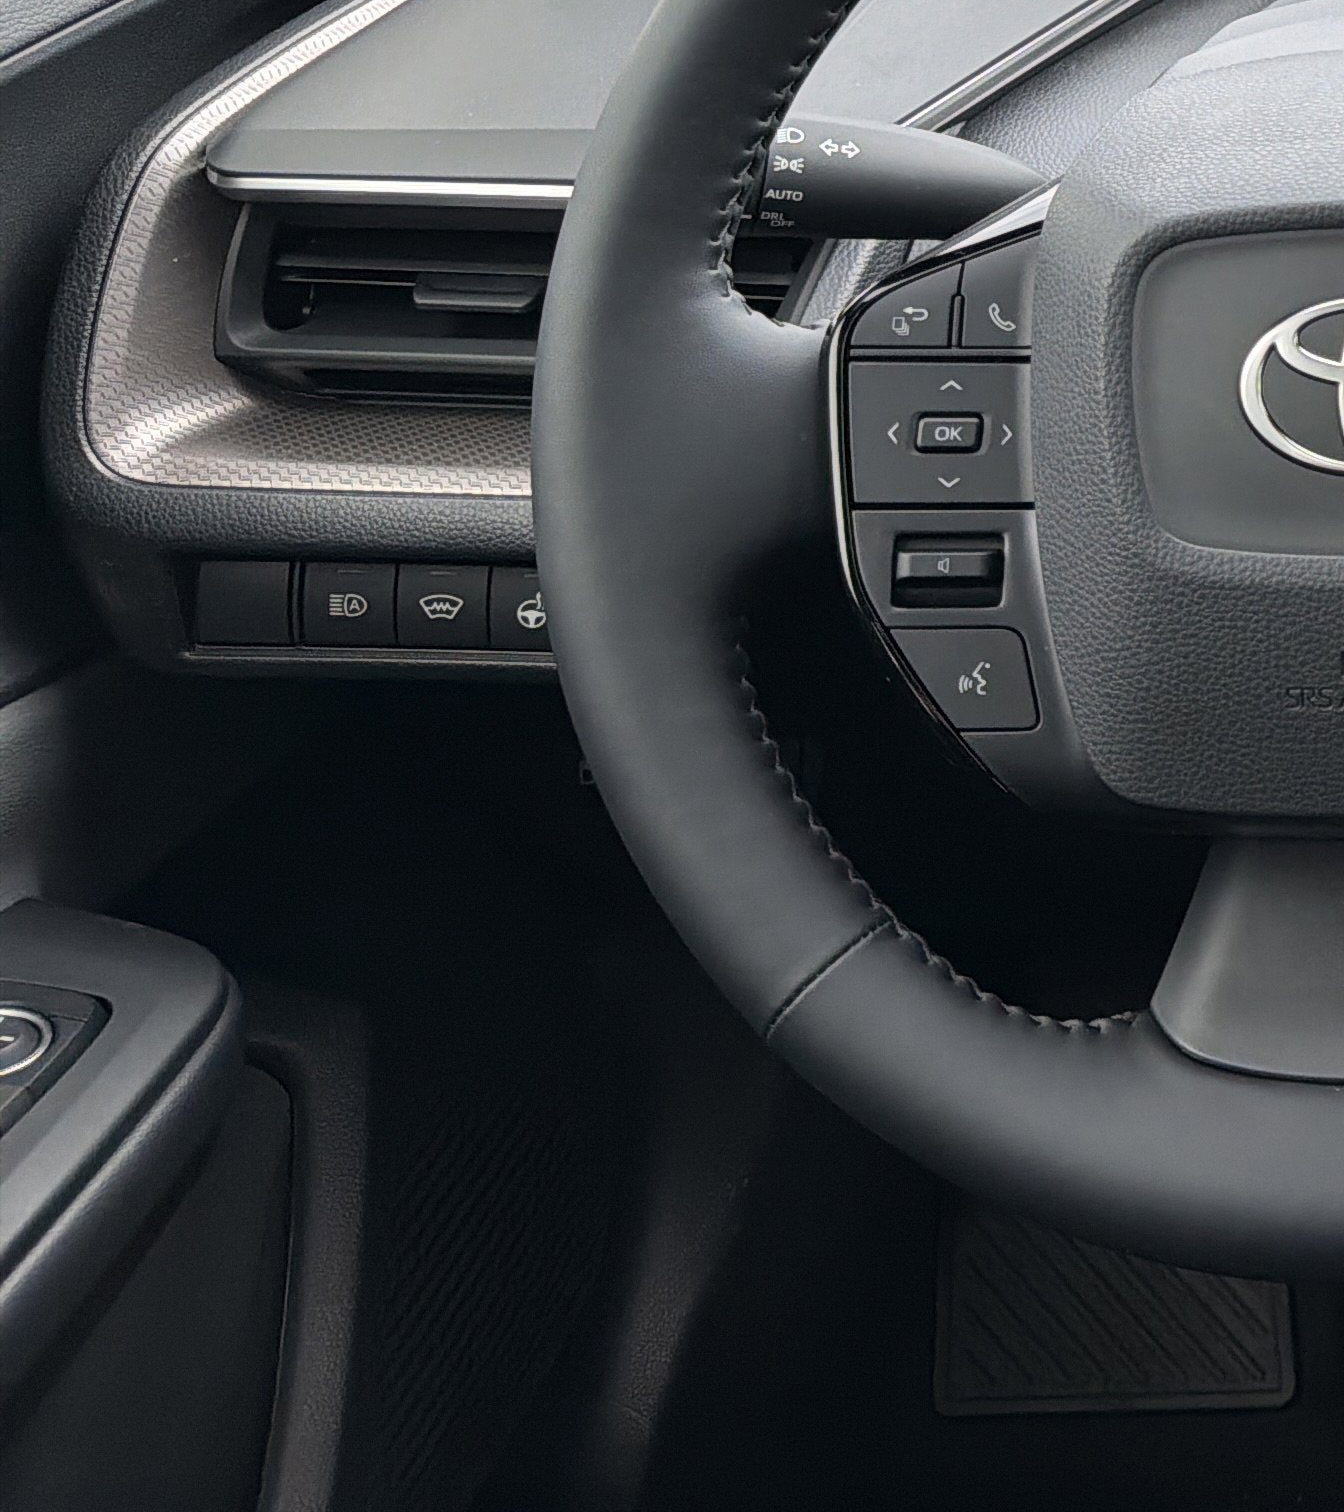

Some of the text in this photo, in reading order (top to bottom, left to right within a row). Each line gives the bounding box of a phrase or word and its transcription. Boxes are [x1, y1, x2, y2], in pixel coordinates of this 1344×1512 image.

[765, 189, 804, 202] AUTO
[760, 211, 785, 222] DRL
[770, 220, 795, 228] OFF
[934, 425, 963, 443] OK
[1284, 687, 1333, 711] SRS
